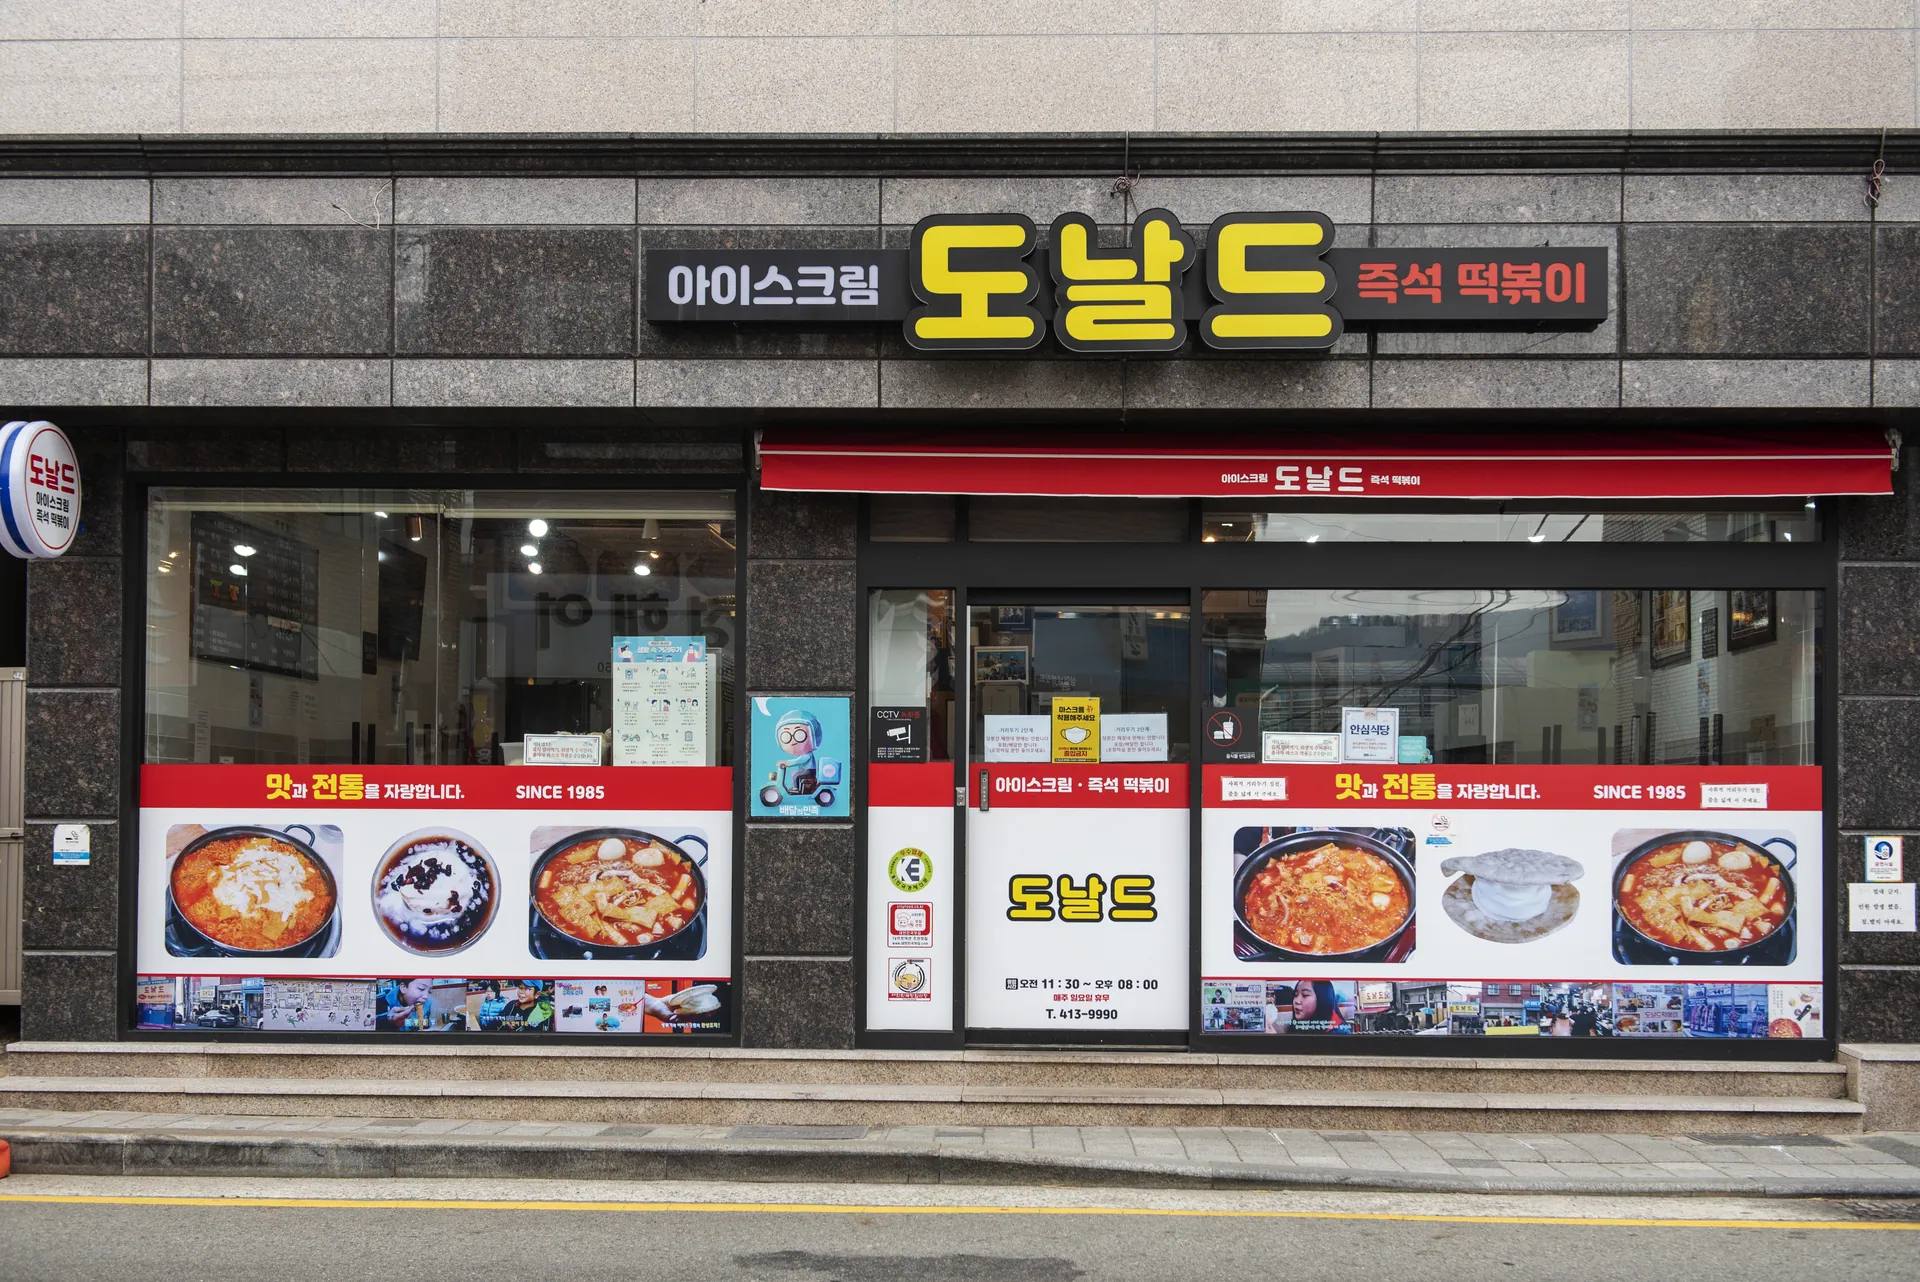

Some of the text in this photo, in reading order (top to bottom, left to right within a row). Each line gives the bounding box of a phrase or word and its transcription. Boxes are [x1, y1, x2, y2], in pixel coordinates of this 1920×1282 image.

[668, 219, 1586, 341] 아이스크림 도날드 즉석 떡볶이
[29, 453, 75, 495] 도날드
[1221, 465, 1420, 492] 아이스크림 도날드 즉석 떡볶이
[35, 491, 70, 513] 아이스크림
[36, 508, 70, 530] 즉석 떡볶이
[876, 710, 900, 719] CCTV
[1057, 714, 1096, 722] 착용해주세요
[1349, 724, 1391, 736] 안심식당
[266, 773, 465, 800] 맛과 전통을 자랑합니다.
[515, 785, 605, 800] SINCE 1985
[995, 777, 1073, 793] 아이스크림
[1088, 777, 1119, 793] 즉석
[1123, 777, 1170, 793] 떡볶이
[1335, 772, 1541, 800] 맛과 전통을 자랑합니다.
[1593, 785, 1687, 799] SINCE 1985
[779, 805, 819, 816] 배달의민족
[1006, 872, 1159, 923] 도날드
[1019, 979, 1038, 989] 오전
[1094, 979, 1113, 989] 오후
[1053, 993, 1110, 1002] 매주 일요일 휴무
[1045, 1008, 1118, 1019] T. 413-9990
